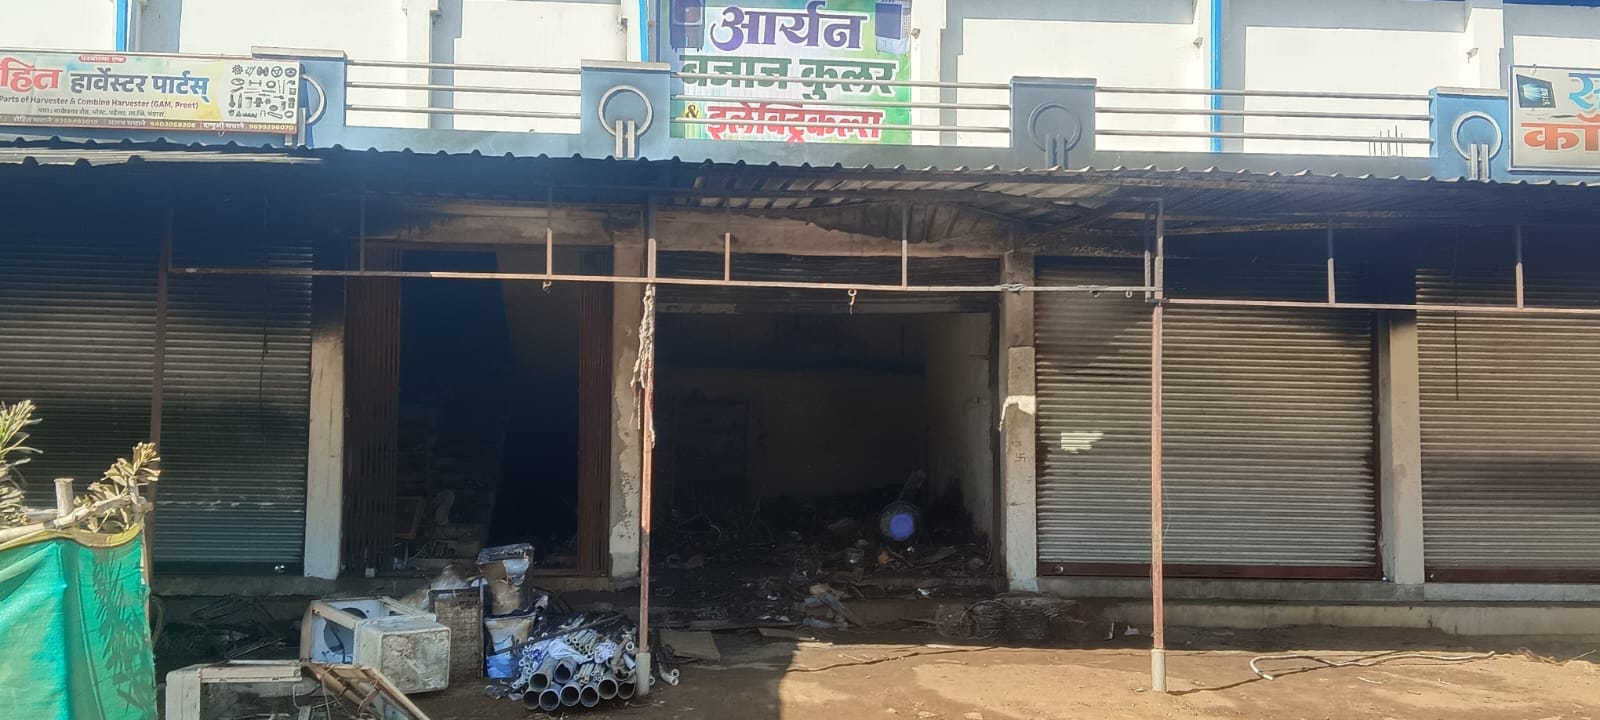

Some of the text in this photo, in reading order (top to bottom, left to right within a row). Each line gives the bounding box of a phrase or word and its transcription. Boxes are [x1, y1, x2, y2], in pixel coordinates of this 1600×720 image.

[710, 1, 868, 52] आर्यन
[70, 68, 148, 93] हार्वेस्टर
[679, 55, 896, 101] बजाज कुलर
[20, 95, 29, 104] of
[30, 96, 68, 105] Harvester
[70, 97, 76, 105] &
[77, 97, 110, 106] Combine
[112, 99, 149, 108] Harvester
[150, 100, 173, 109] (GAM,
[175, 101, 198, 110] Preet)
